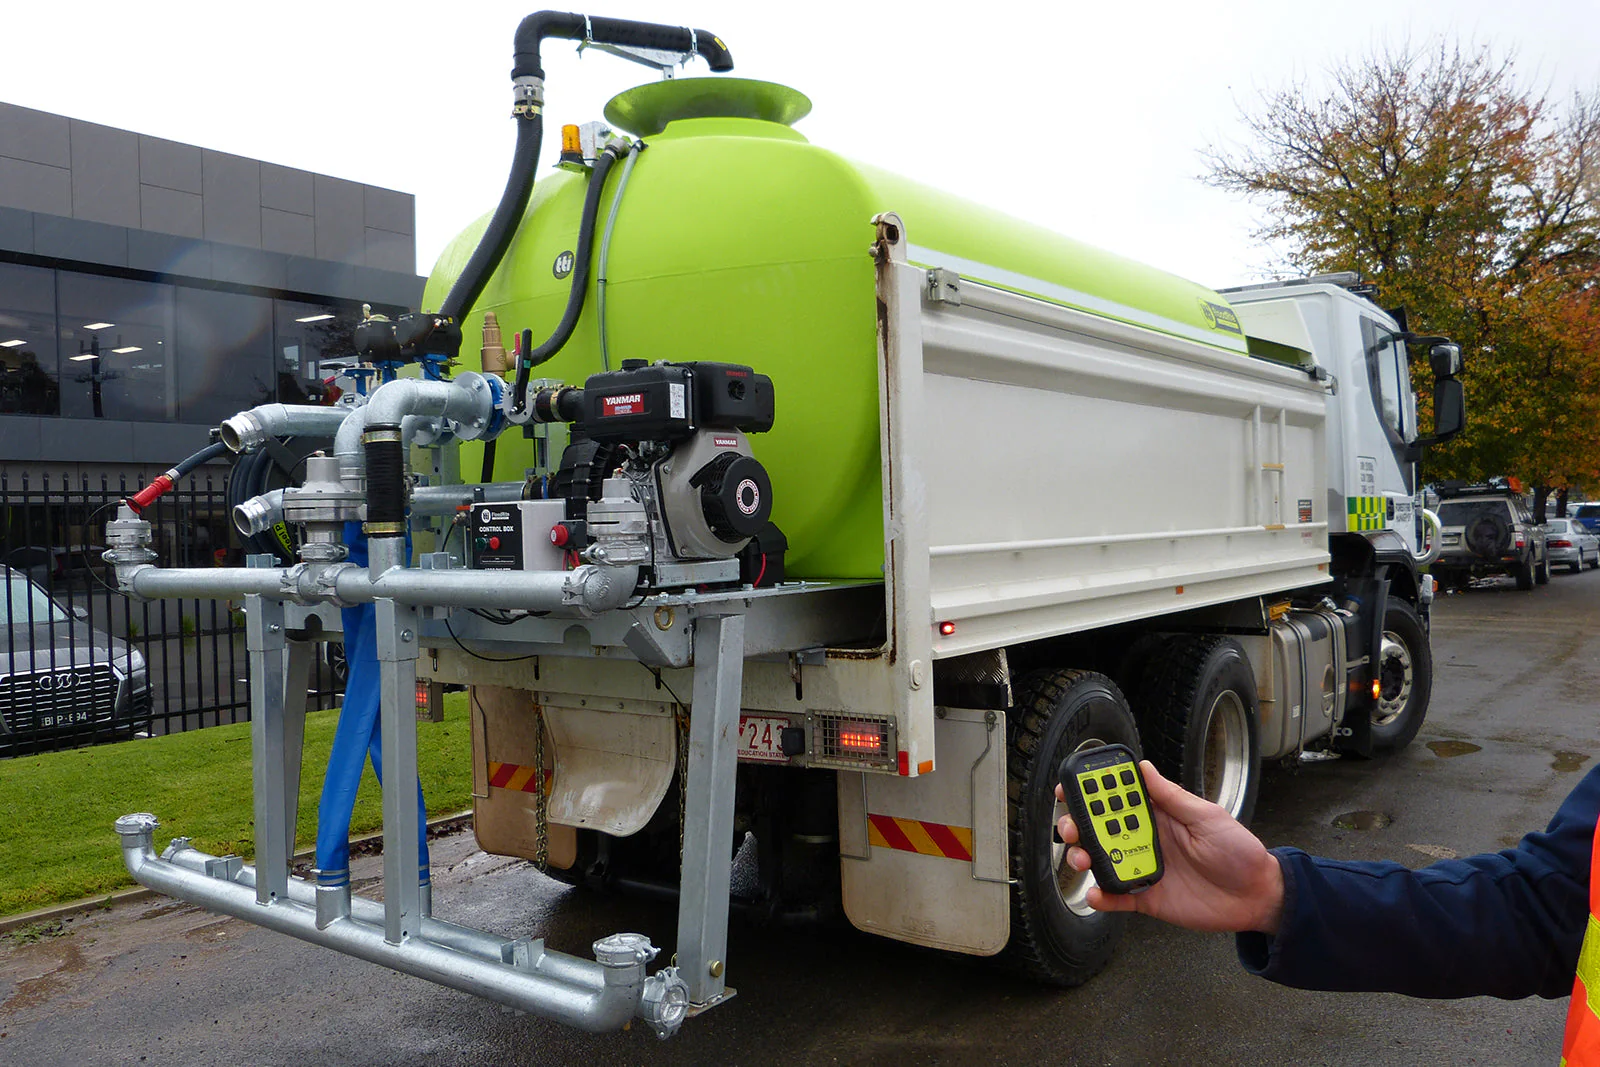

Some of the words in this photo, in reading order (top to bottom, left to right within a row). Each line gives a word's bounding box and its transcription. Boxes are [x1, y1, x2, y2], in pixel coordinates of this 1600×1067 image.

[605, 394, 641, 405] YANMAR
[715, 438, 737, 446] YANMAR
[738, 748, 768, 757] EDUCATION
